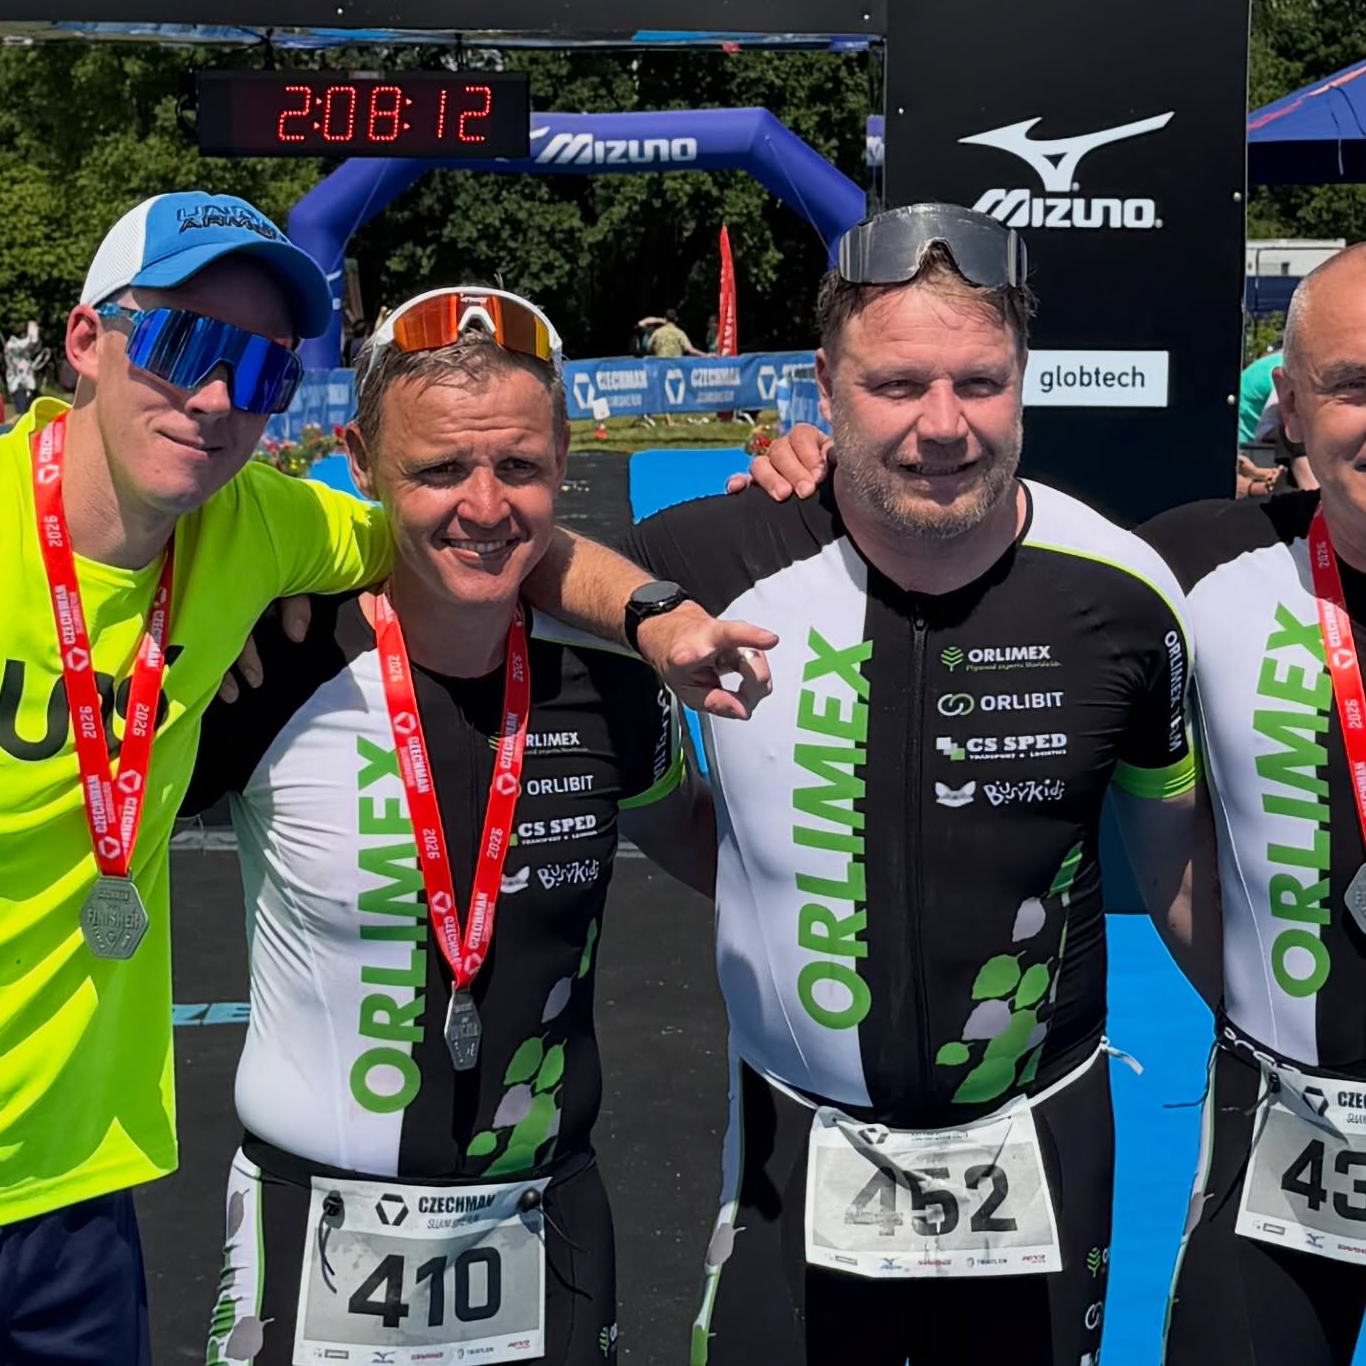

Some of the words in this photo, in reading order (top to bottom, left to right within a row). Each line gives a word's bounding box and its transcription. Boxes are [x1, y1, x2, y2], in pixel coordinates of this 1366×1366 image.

[1040, 366, 1147, 392] globtech
[44, 515, 63, 547] 2026
[968, 645, 1052, 663] ORLIMEX
[980, 692, 1065, 712] ORLIBIT
[1344, 699, 1363, 730] 2026
[79, 705, 97, 739] 2026
[132, 703, 150, 737] 2026
[526, 732, 580, 748] RLIMEX
[966, 737, 998, 753] CS
[1003, 733, 1068, 751] SPED
[527, 775, 594, 796] ORLIBIT
[1252, 600, 1332, 998] ORLIMEX
[518, 821, 545, 838] CS
[550, 815, 596, 834] SPED
[792, 625, 874, 1031] ORLIMEX
[422, 828, 441, 860] 2026
[350, 734, 428, 1115] ORLIMEX
[844, 1163, 1018, 1237] 452
[348, 1246, 502, 1328] 410
